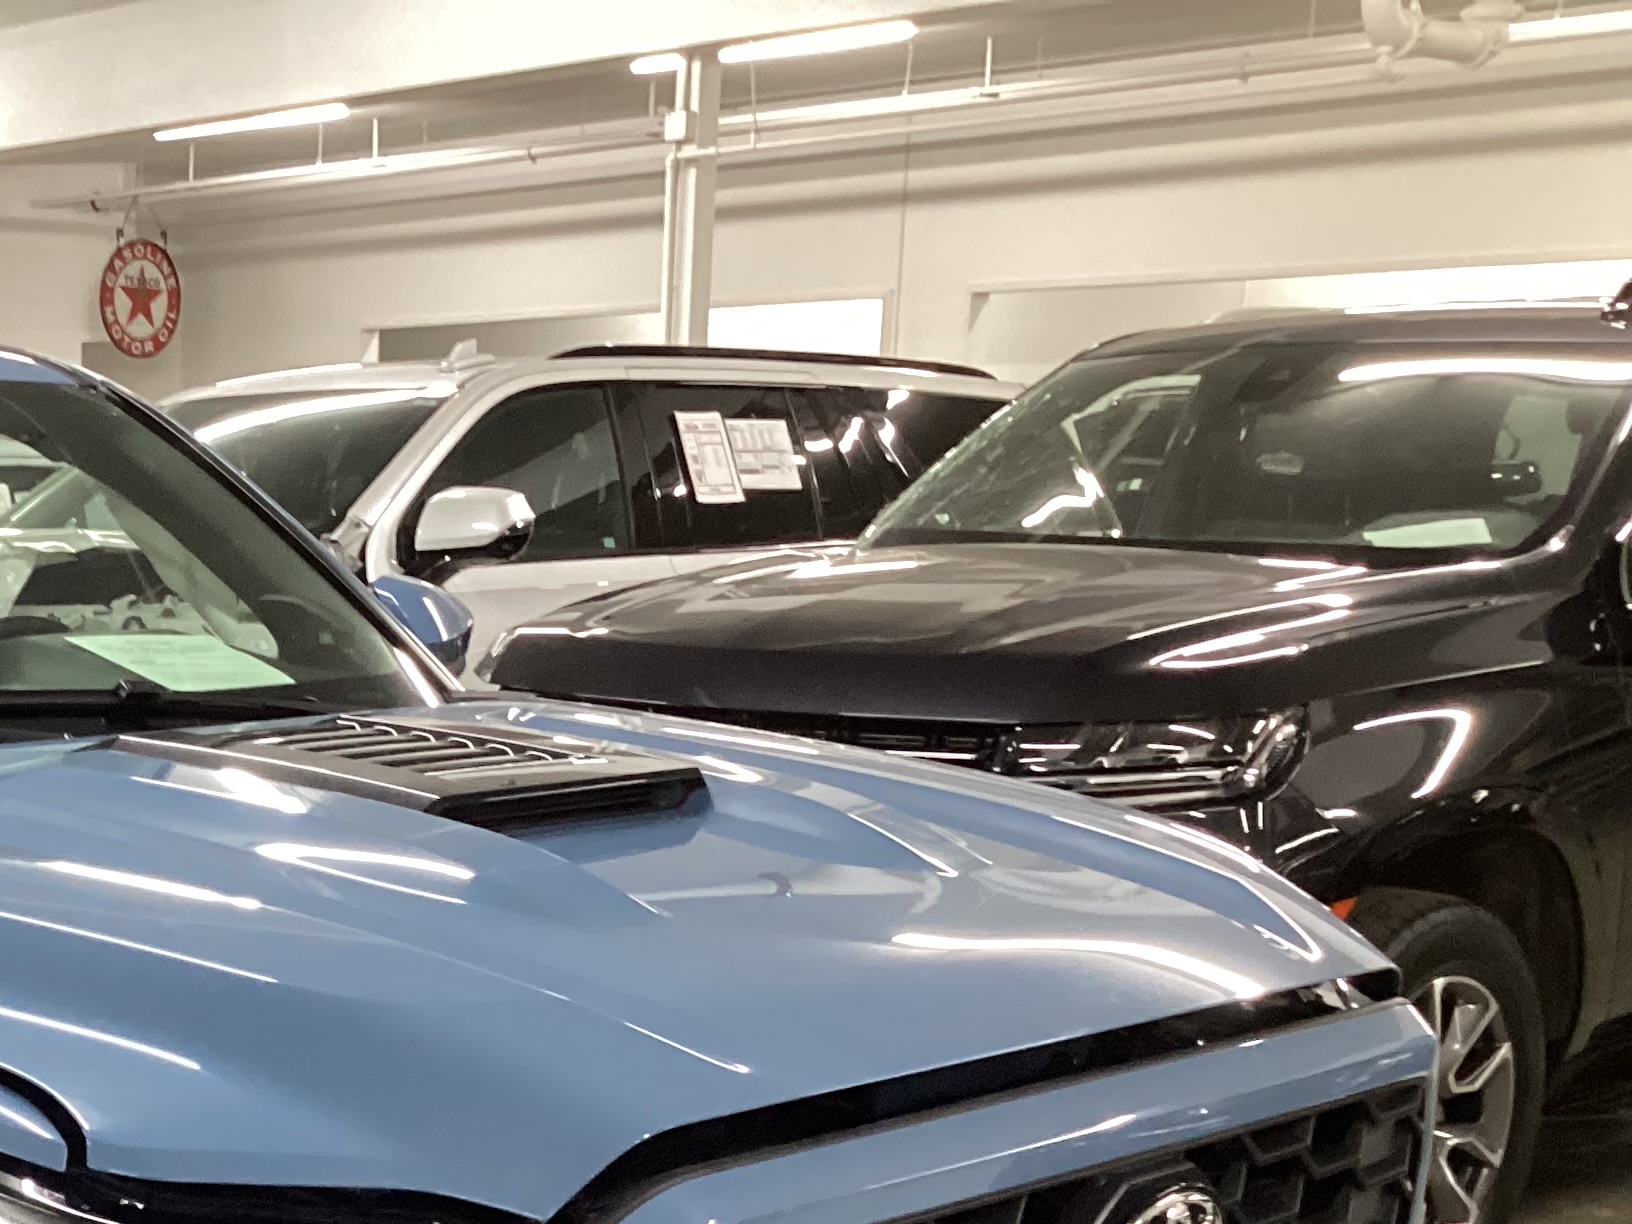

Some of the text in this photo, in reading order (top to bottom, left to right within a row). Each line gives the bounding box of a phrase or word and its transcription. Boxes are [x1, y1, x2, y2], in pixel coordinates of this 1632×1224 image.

[105, 244, 177, 290] GASOLINE
[104, 306, 177, 355] MOTOR OIL
